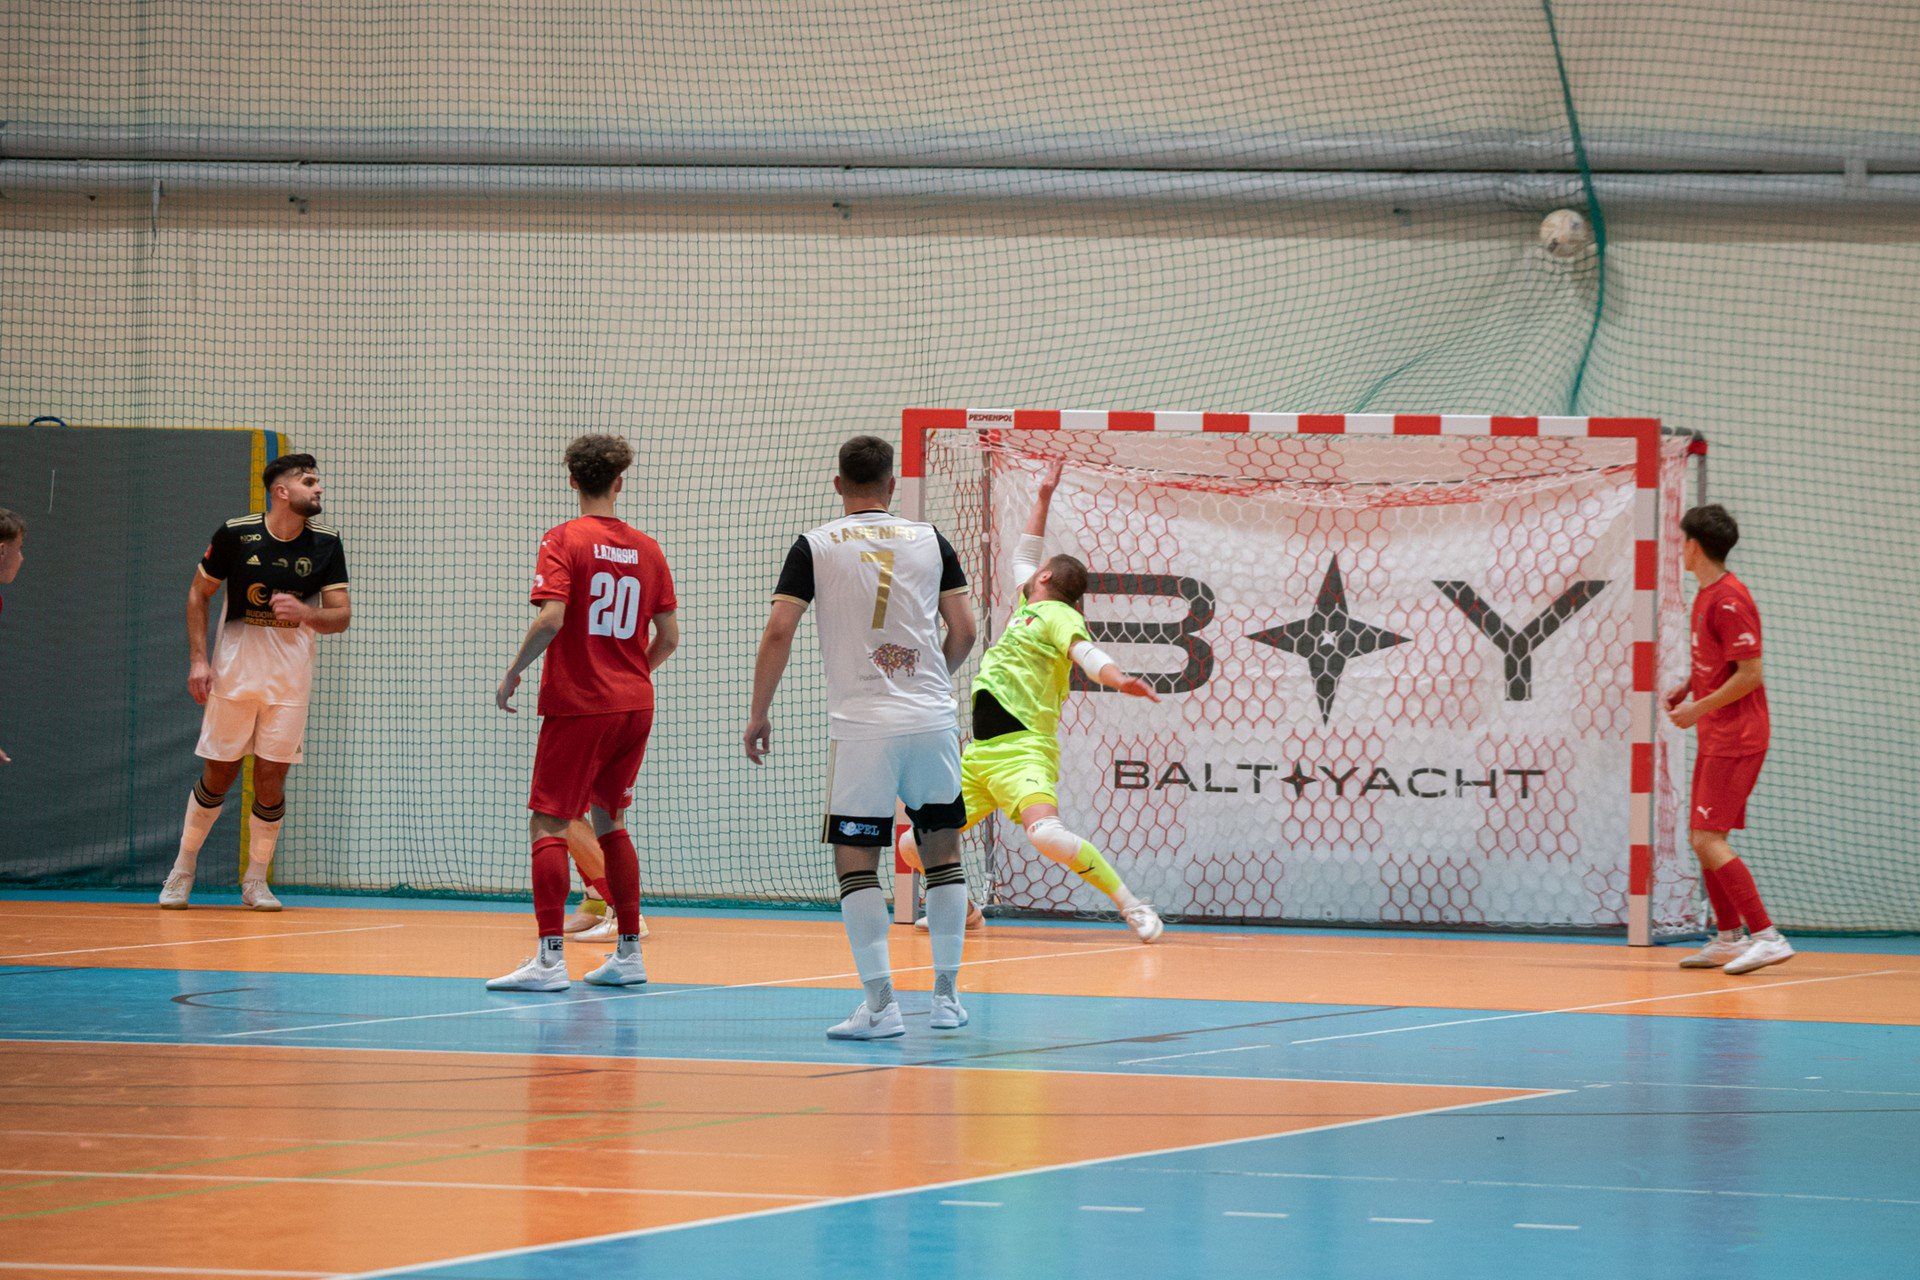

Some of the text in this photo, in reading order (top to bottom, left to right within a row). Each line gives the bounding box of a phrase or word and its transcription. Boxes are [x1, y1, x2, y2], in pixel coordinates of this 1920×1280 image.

[593, 543, 639, 565] ŁAZARSKI
[588, 571, 641, 640] 20
[860, 551, 894, 630] 7
[1067, 572, 1613, 701] B Y
[1114, 760, 1546, 799] BALT YACHT
